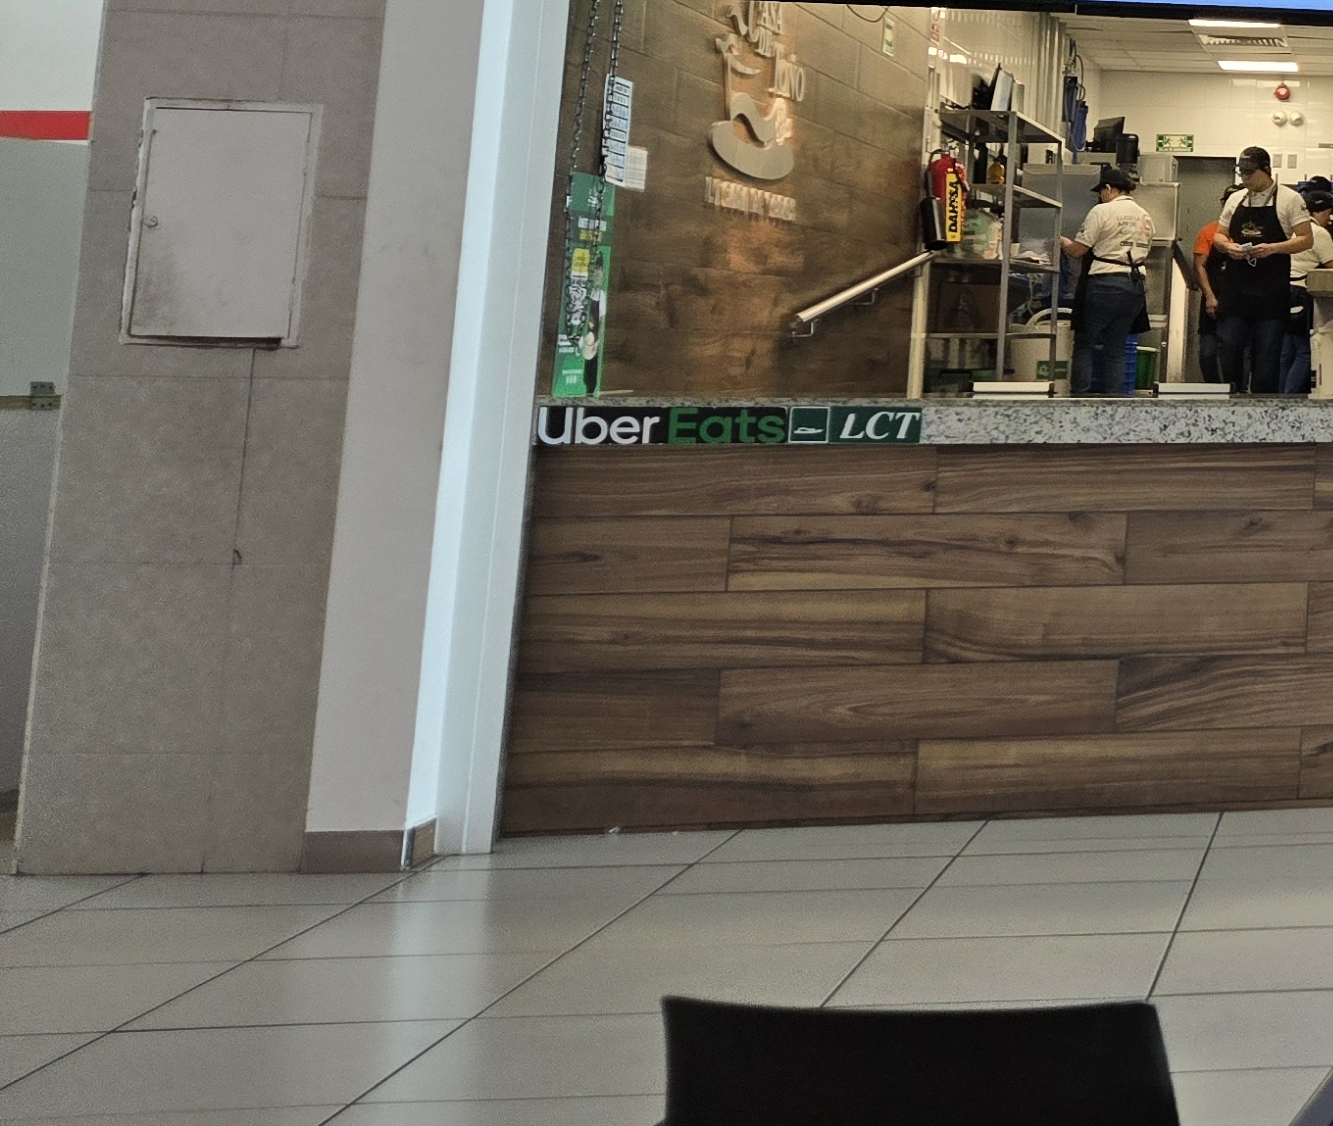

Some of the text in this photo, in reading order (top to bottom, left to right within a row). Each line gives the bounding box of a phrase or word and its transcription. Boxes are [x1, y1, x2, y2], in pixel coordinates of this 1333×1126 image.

[538, 406, 786, 445] Uber Eats
[839, 411, 920, 440] LCT
